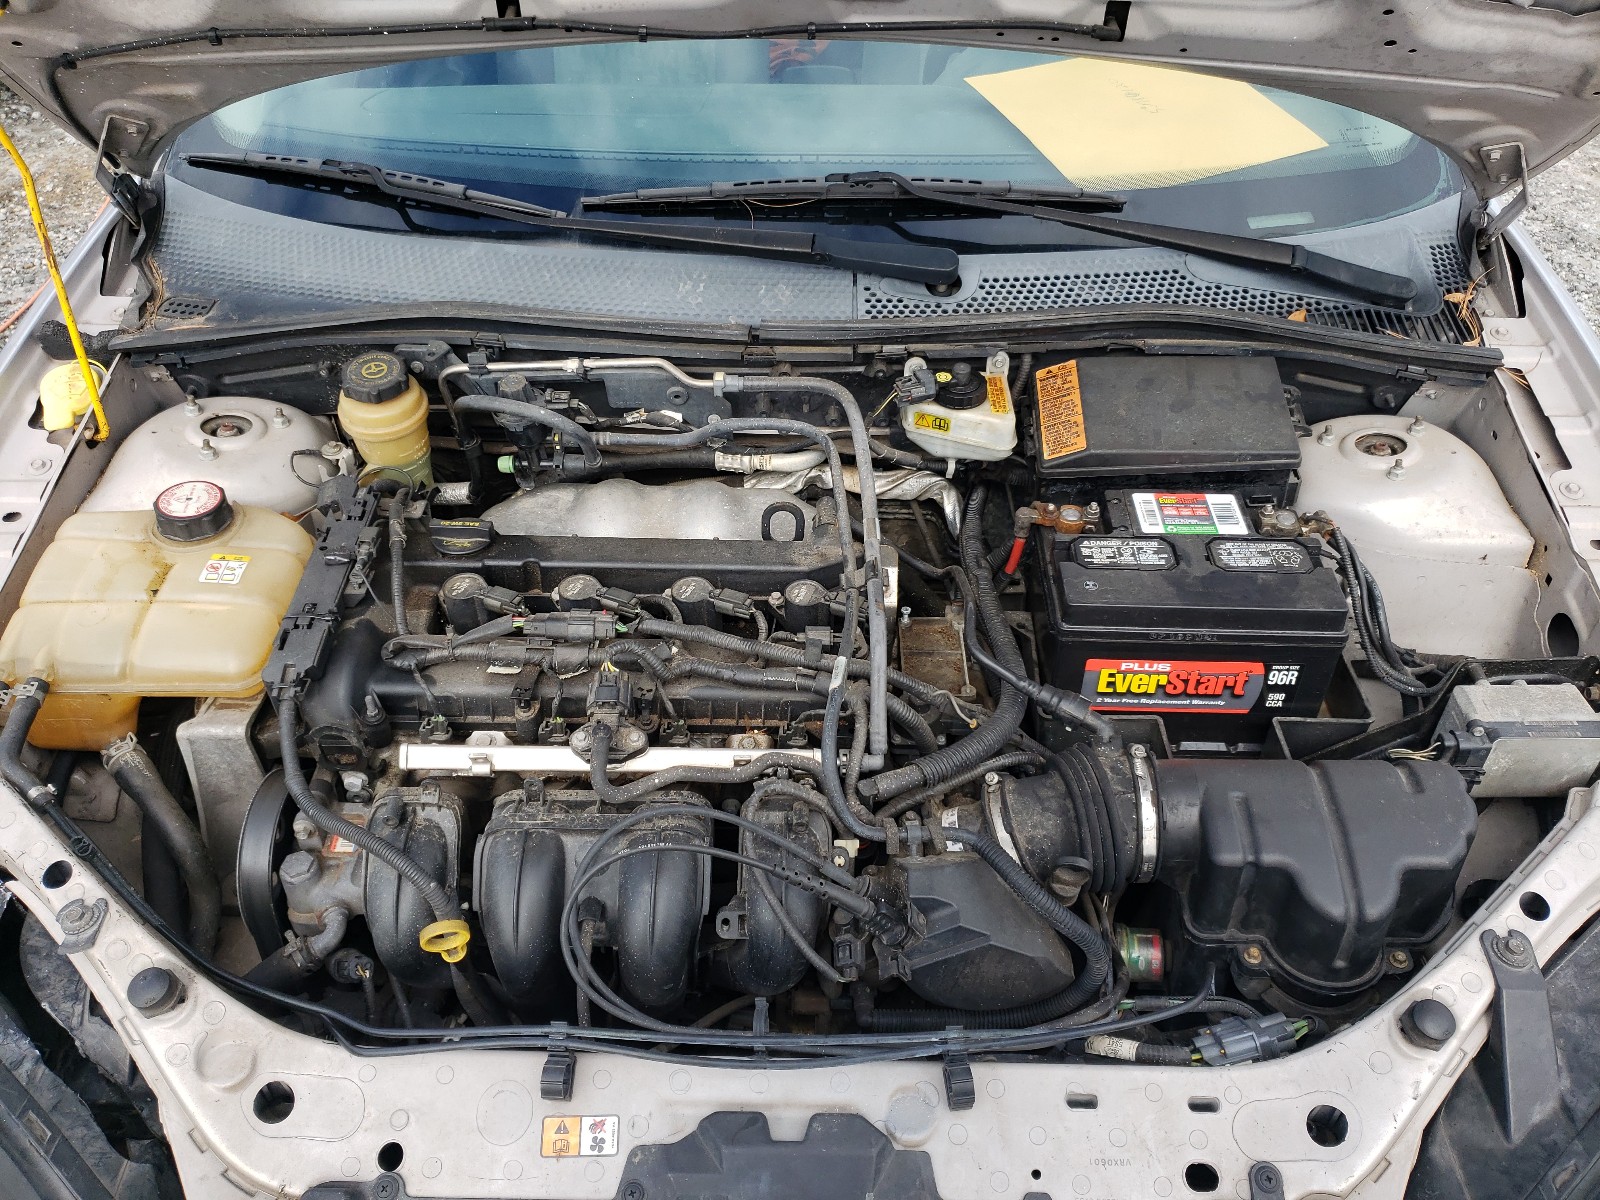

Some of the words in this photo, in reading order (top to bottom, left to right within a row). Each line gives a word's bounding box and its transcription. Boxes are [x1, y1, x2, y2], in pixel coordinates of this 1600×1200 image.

[1121, 662, 1172, 671] PLUS
[1097, 668, 1249, 696] EverStart
[1267, 671, 1299, 685] 96R
[1267, 693, 1286, 701] 590
